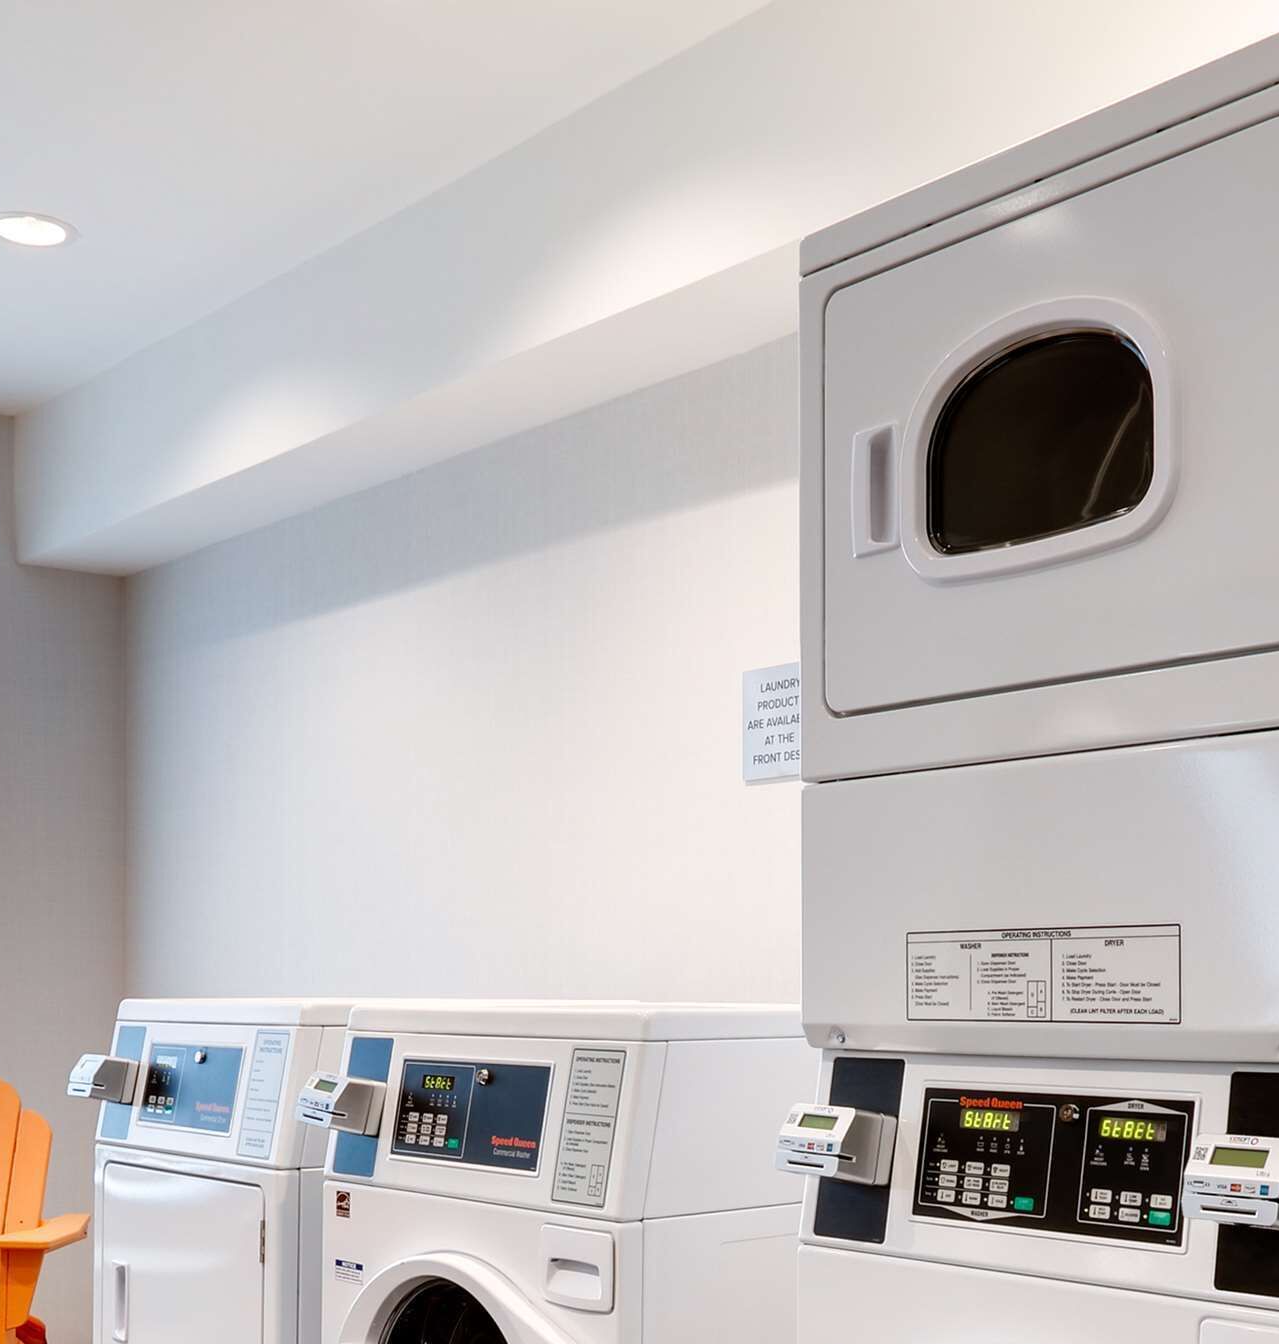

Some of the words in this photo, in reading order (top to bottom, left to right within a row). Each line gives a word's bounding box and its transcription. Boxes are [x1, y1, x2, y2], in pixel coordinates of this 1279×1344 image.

[748, 719, 764, 730] ARE
[765, 735, 774, 745] AT
[778, 732, 794, 744] THE
[753, 752, 781, 765] FRONT
[1032, 930, 1071, 938] INSTRUCTIONS
[959, 1096, 990, 1108] Speed
[991, 1097, 1023, 1109] Queen
[491, 1135, 514, 1147] Speed
[514, 1137, 536, 1149] Queen
